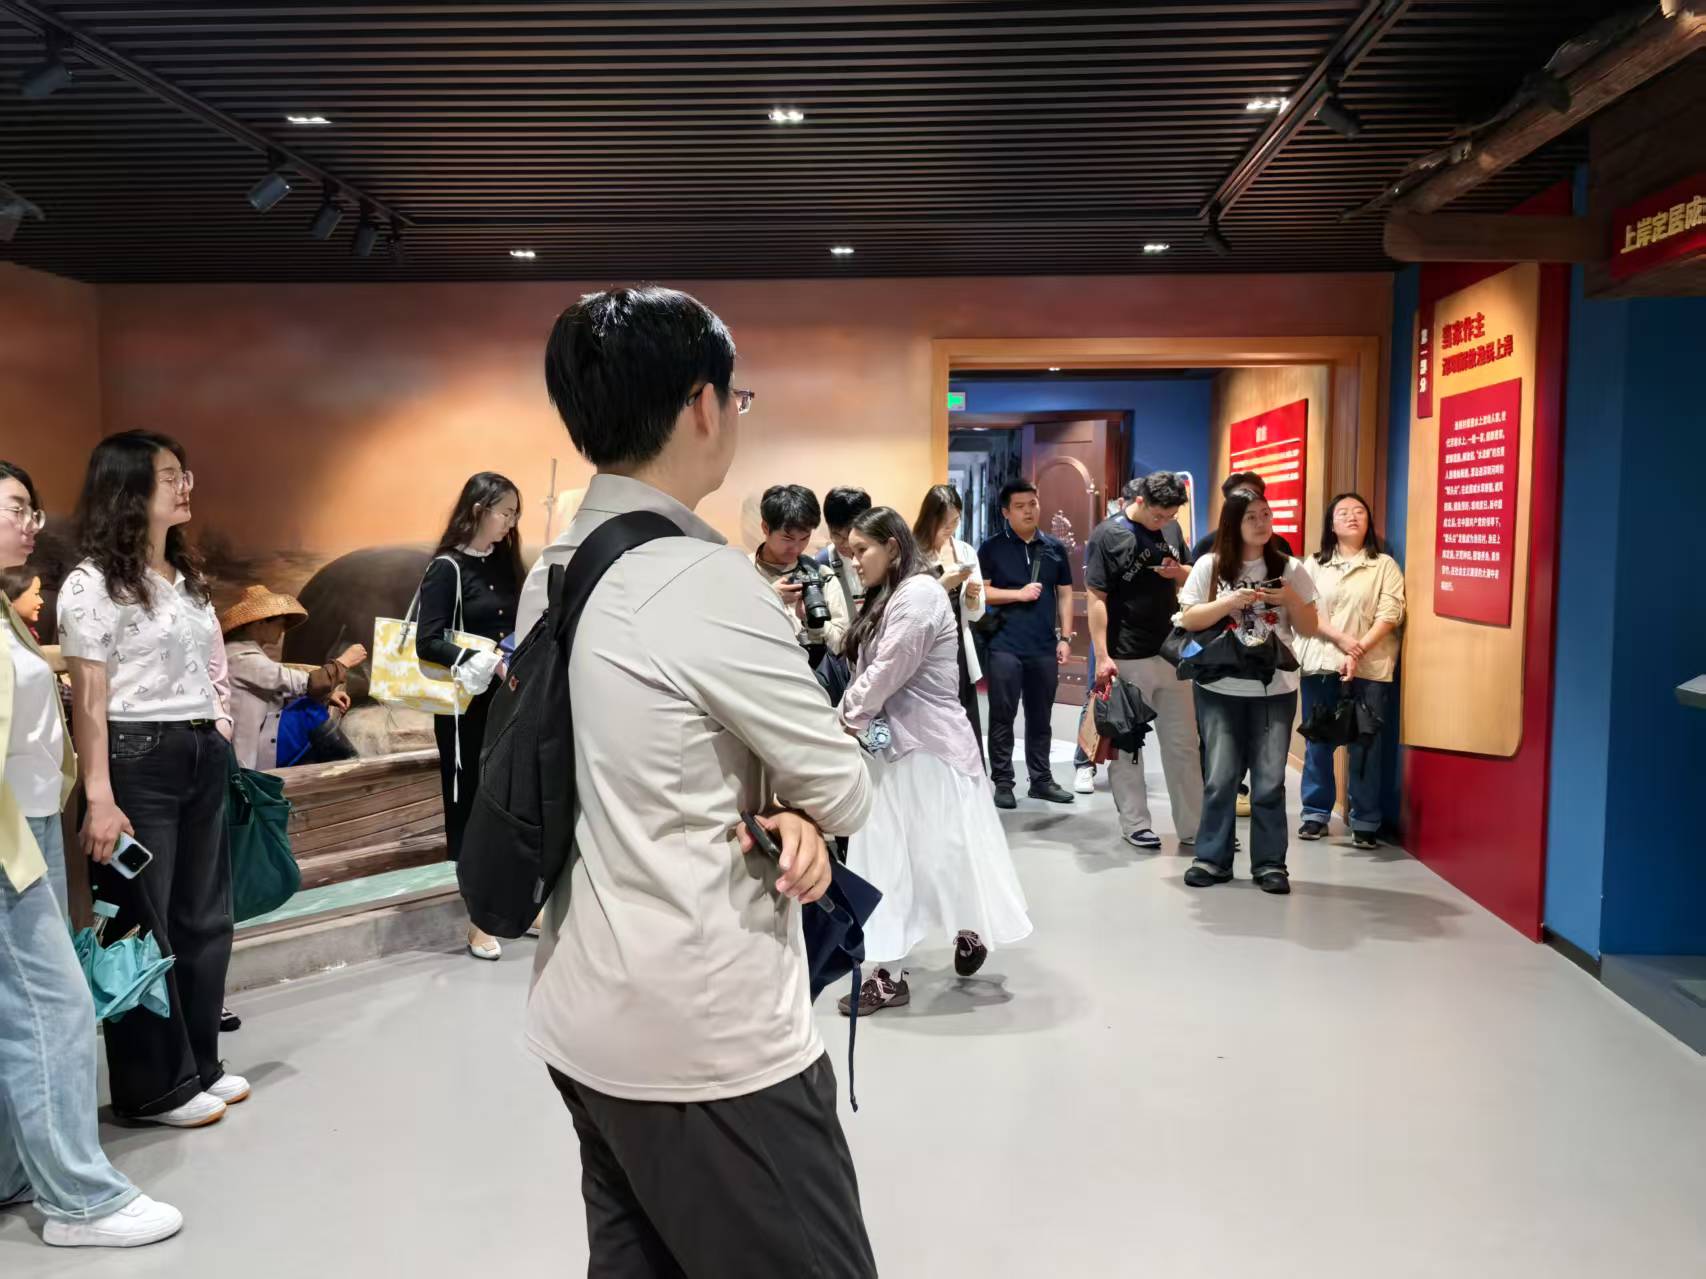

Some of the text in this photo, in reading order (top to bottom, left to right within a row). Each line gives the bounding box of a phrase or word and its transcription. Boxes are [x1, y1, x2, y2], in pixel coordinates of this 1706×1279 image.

[1620, 195, 1706, 254] 上岸定居成
